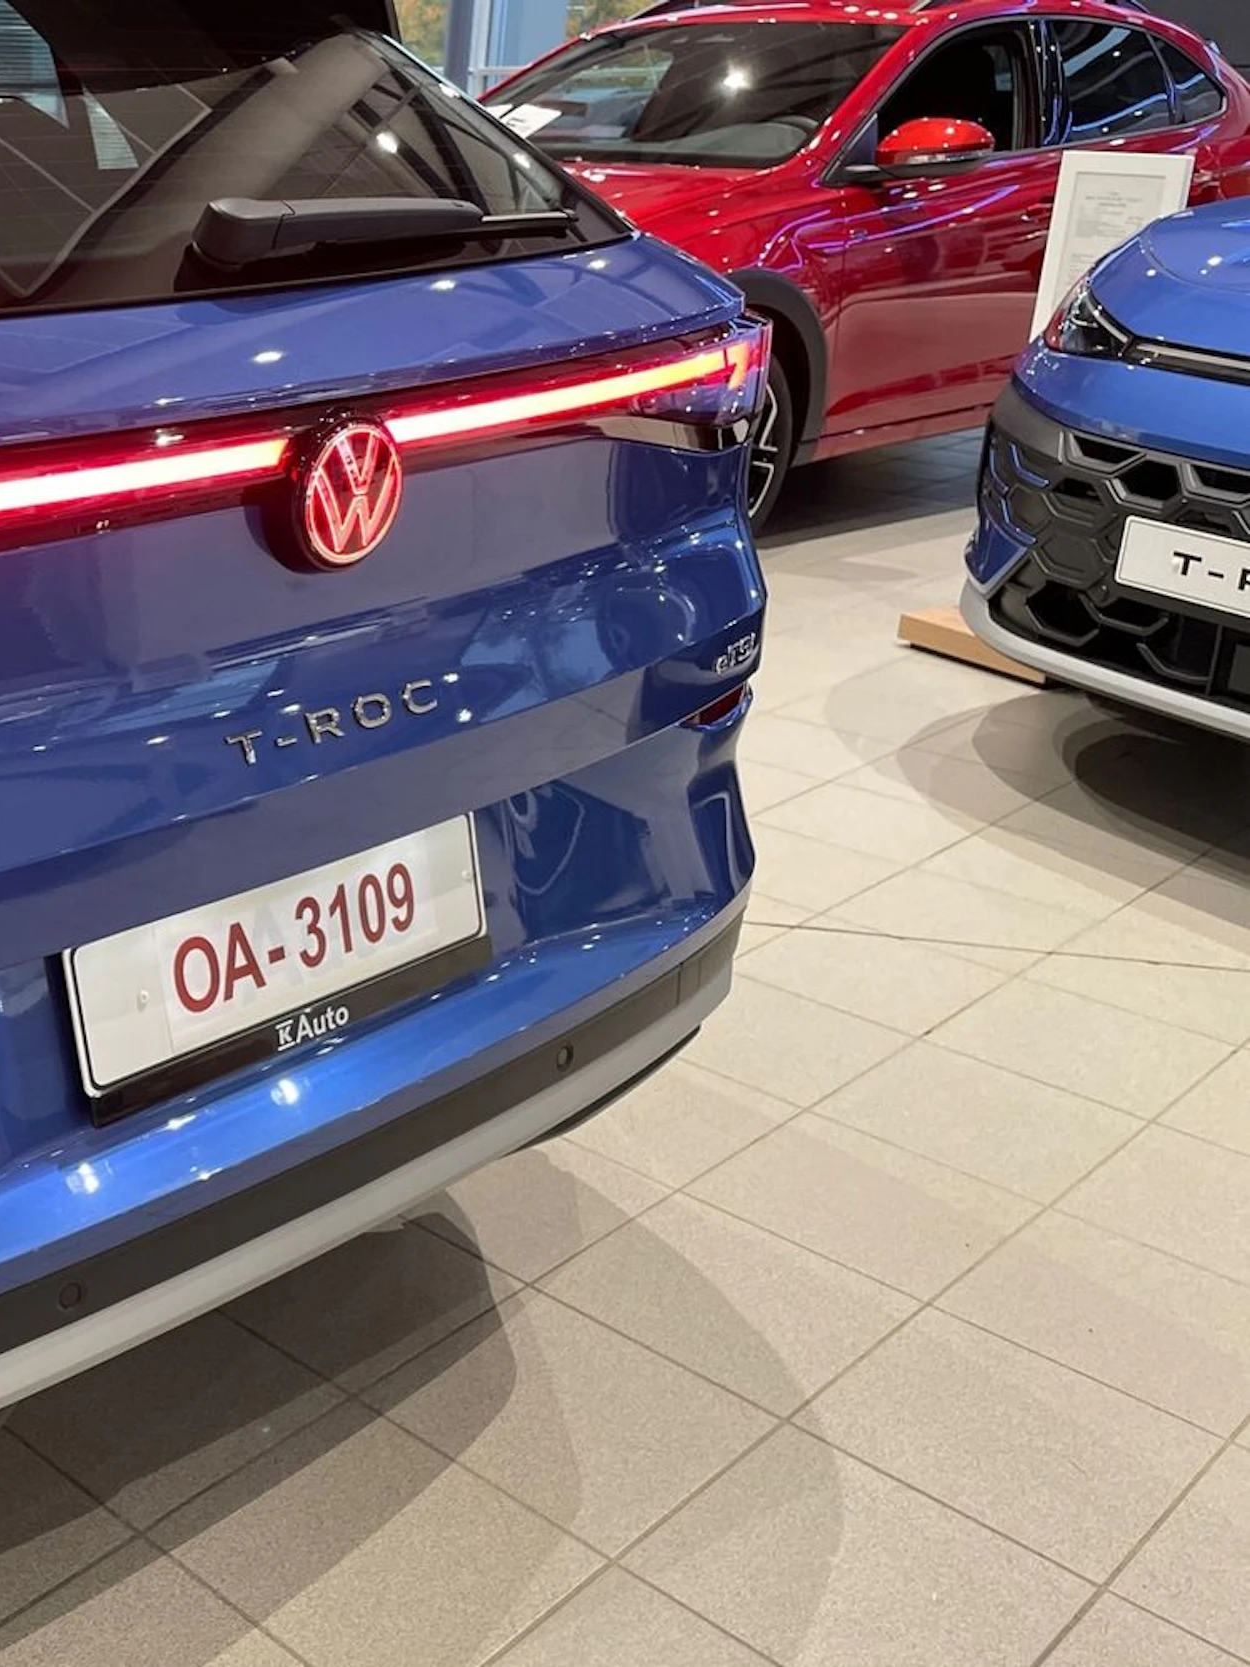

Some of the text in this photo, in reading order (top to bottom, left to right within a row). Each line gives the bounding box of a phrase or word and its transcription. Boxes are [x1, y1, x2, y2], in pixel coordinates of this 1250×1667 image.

[307, 423, 402, 564] VW
[225, 679, 437, 764] T-ROC
[174, 863, 414, 1013] OA-3109
